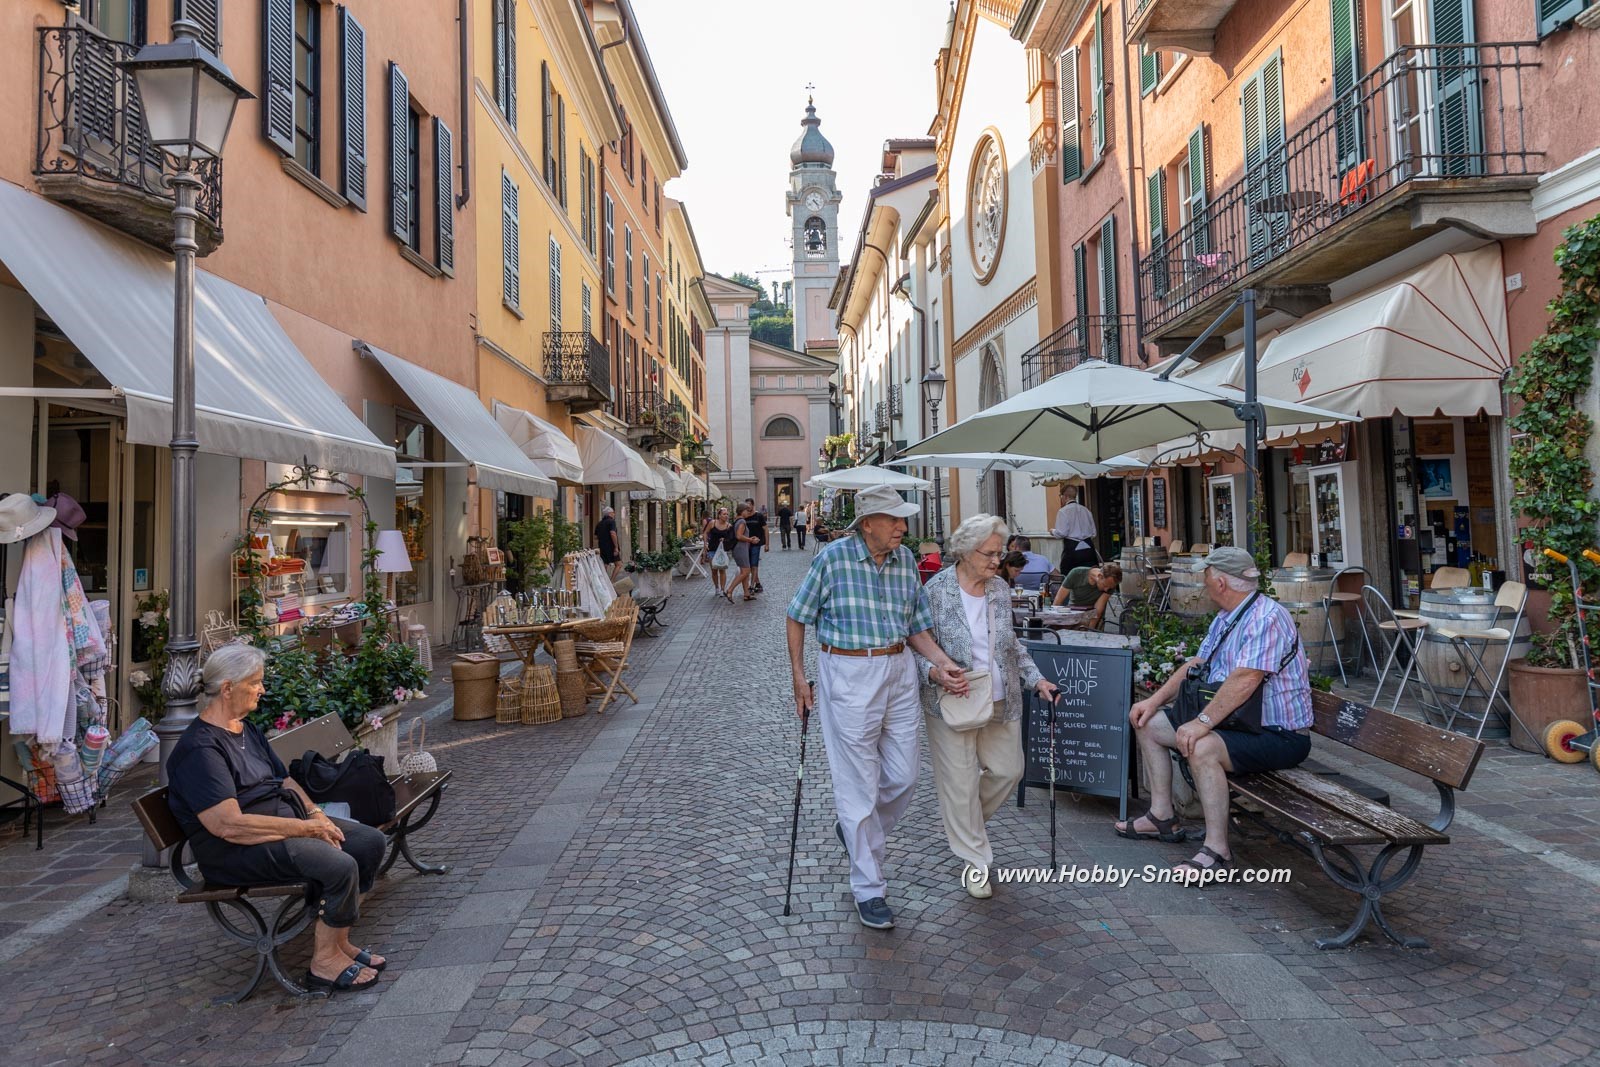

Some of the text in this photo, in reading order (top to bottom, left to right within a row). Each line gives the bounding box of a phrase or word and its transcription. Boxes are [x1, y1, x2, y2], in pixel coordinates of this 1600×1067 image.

[1052, 657, 1099, 679] WINE
[1058, 678, 1098, 696] SHOP
[1040, 709, 1084, 718] DESTATION
[1039, 756, 1061, 764] APEOL
[1042, 766, 1072, 781] JOIN
[1078, 770, 1095, 783] US
